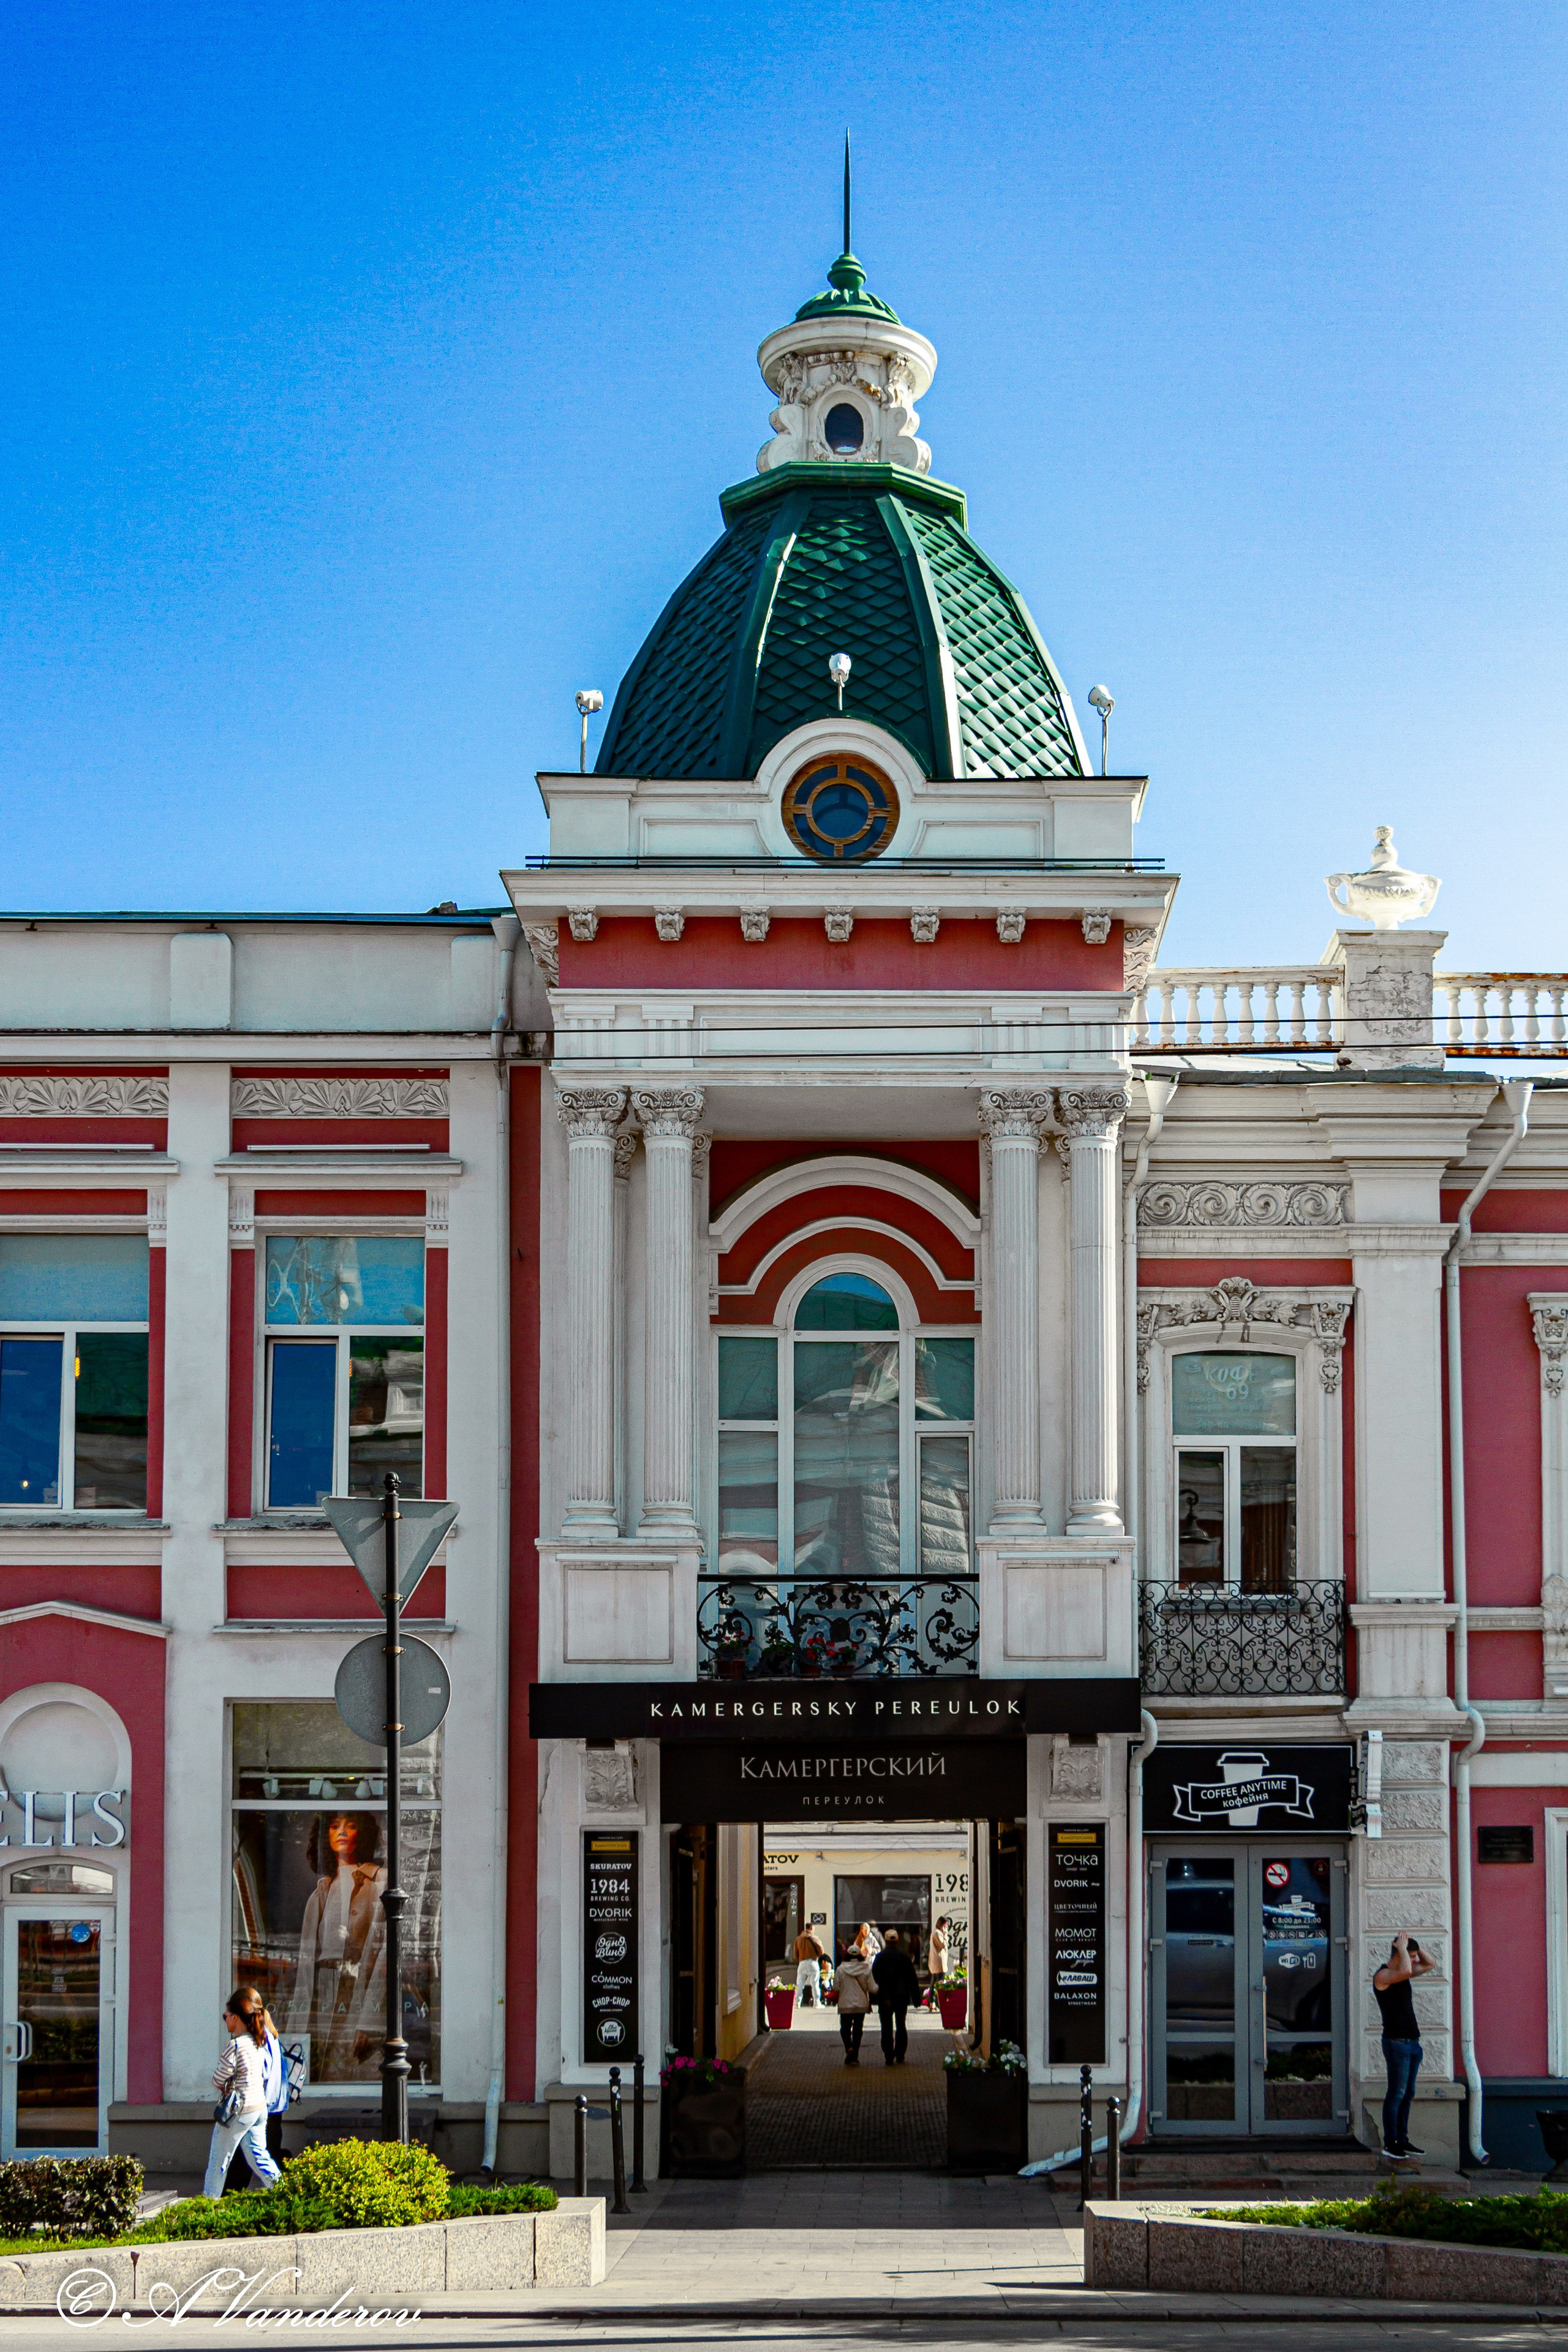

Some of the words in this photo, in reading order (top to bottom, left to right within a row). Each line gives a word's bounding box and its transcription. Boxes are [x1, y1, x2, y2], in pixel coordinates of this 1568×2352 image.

[1226, 1382, 1249, 1400] 69
[651, 1702, 856, 1717] KAMERGERSKY
[875, 1700, 1021, 1715] PEREULOK
[741, 1752, 946, 1779] КАМЕРГЕРСКИЙ
[1200, 1787, 1238, 1800] COFFEE
[1240, 1780, 1287, 1795] ANYTIME
[803, 1796, 885, 1805] ПЕРЕУЛОК
[1223, 1793, 1269, 1807] кофейня
[590, 1879, 630, 1894] 1984
[589, 1908, 632, 1917] DVORIK
[1055, 1950, 1097, 1959] ЛЮКЛЕР
[592, 1996, 630, 2008] CHOP-CHOP
